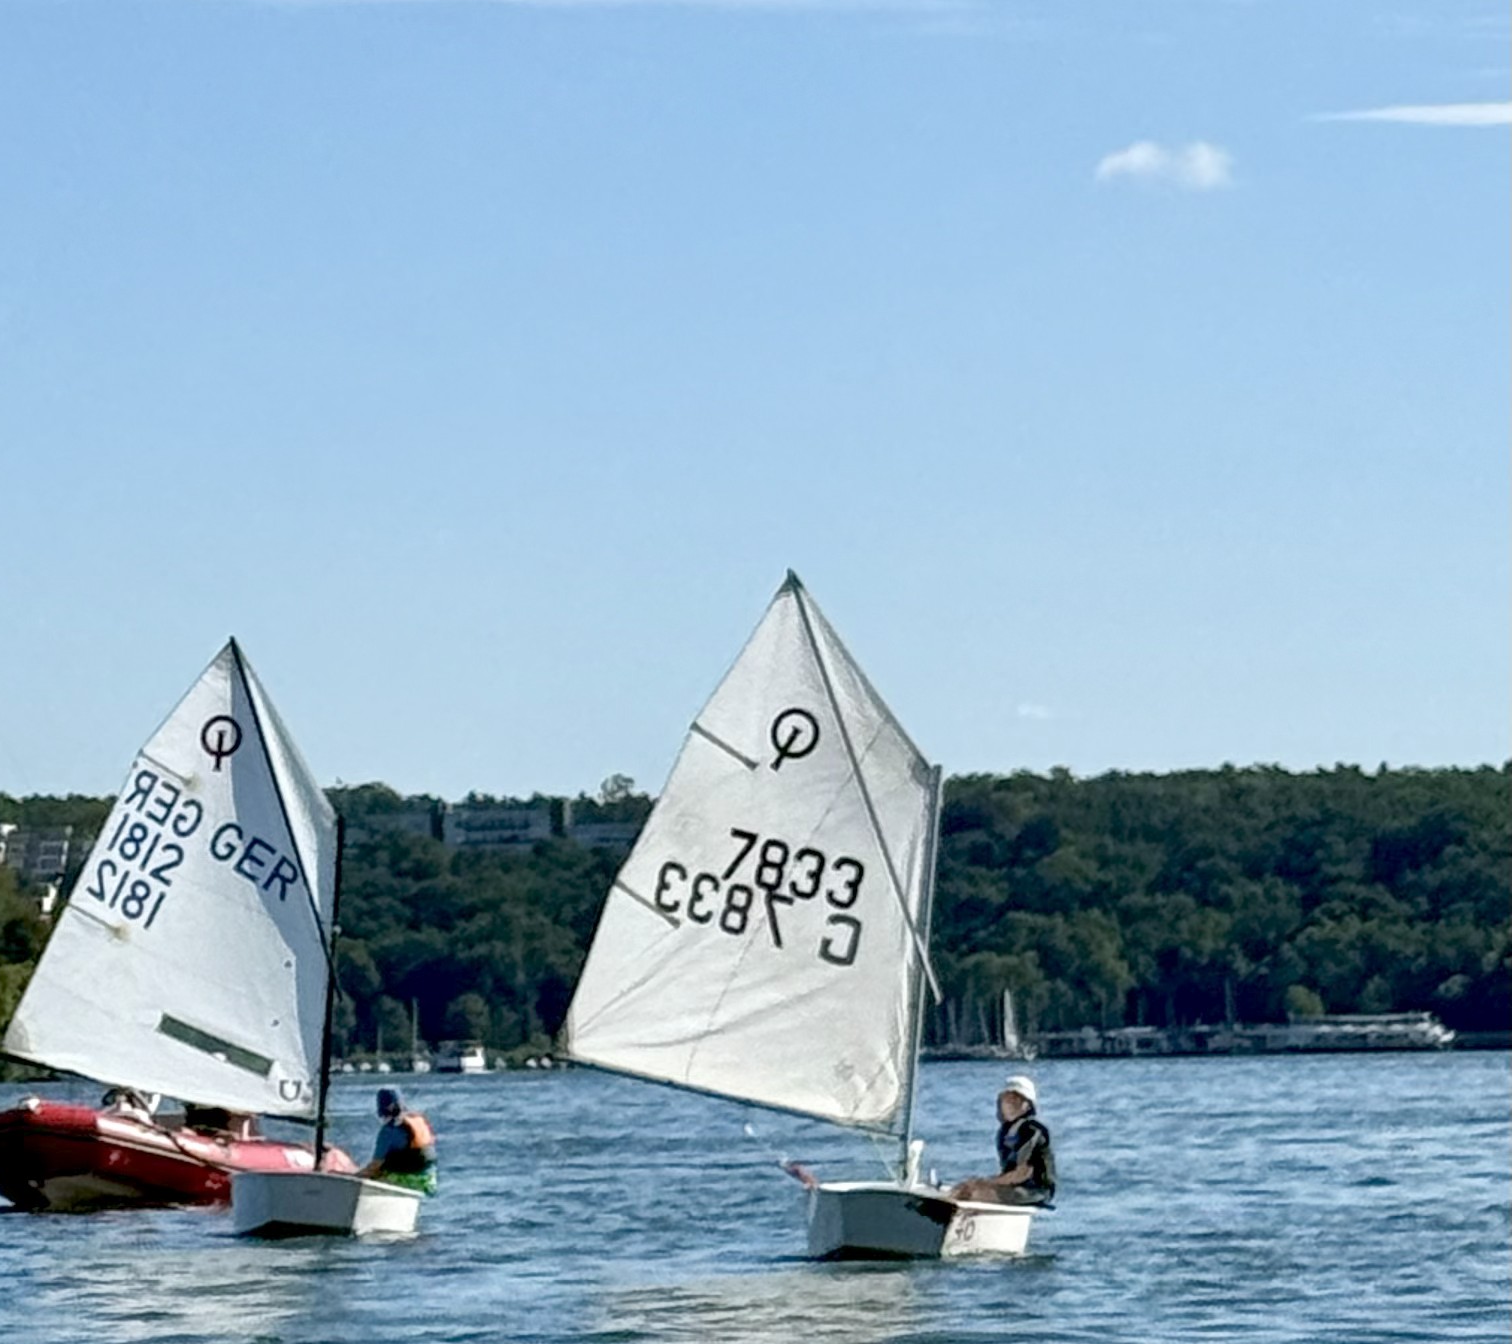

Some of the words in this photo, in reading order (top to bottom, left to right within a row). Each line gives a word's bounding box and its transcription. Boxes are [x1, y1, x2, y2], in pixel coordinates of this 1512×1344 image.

[107, 813, 184, 887] 1812
[210, 823, 298, 901] GER
[722, 827, 864, 909] 7833
